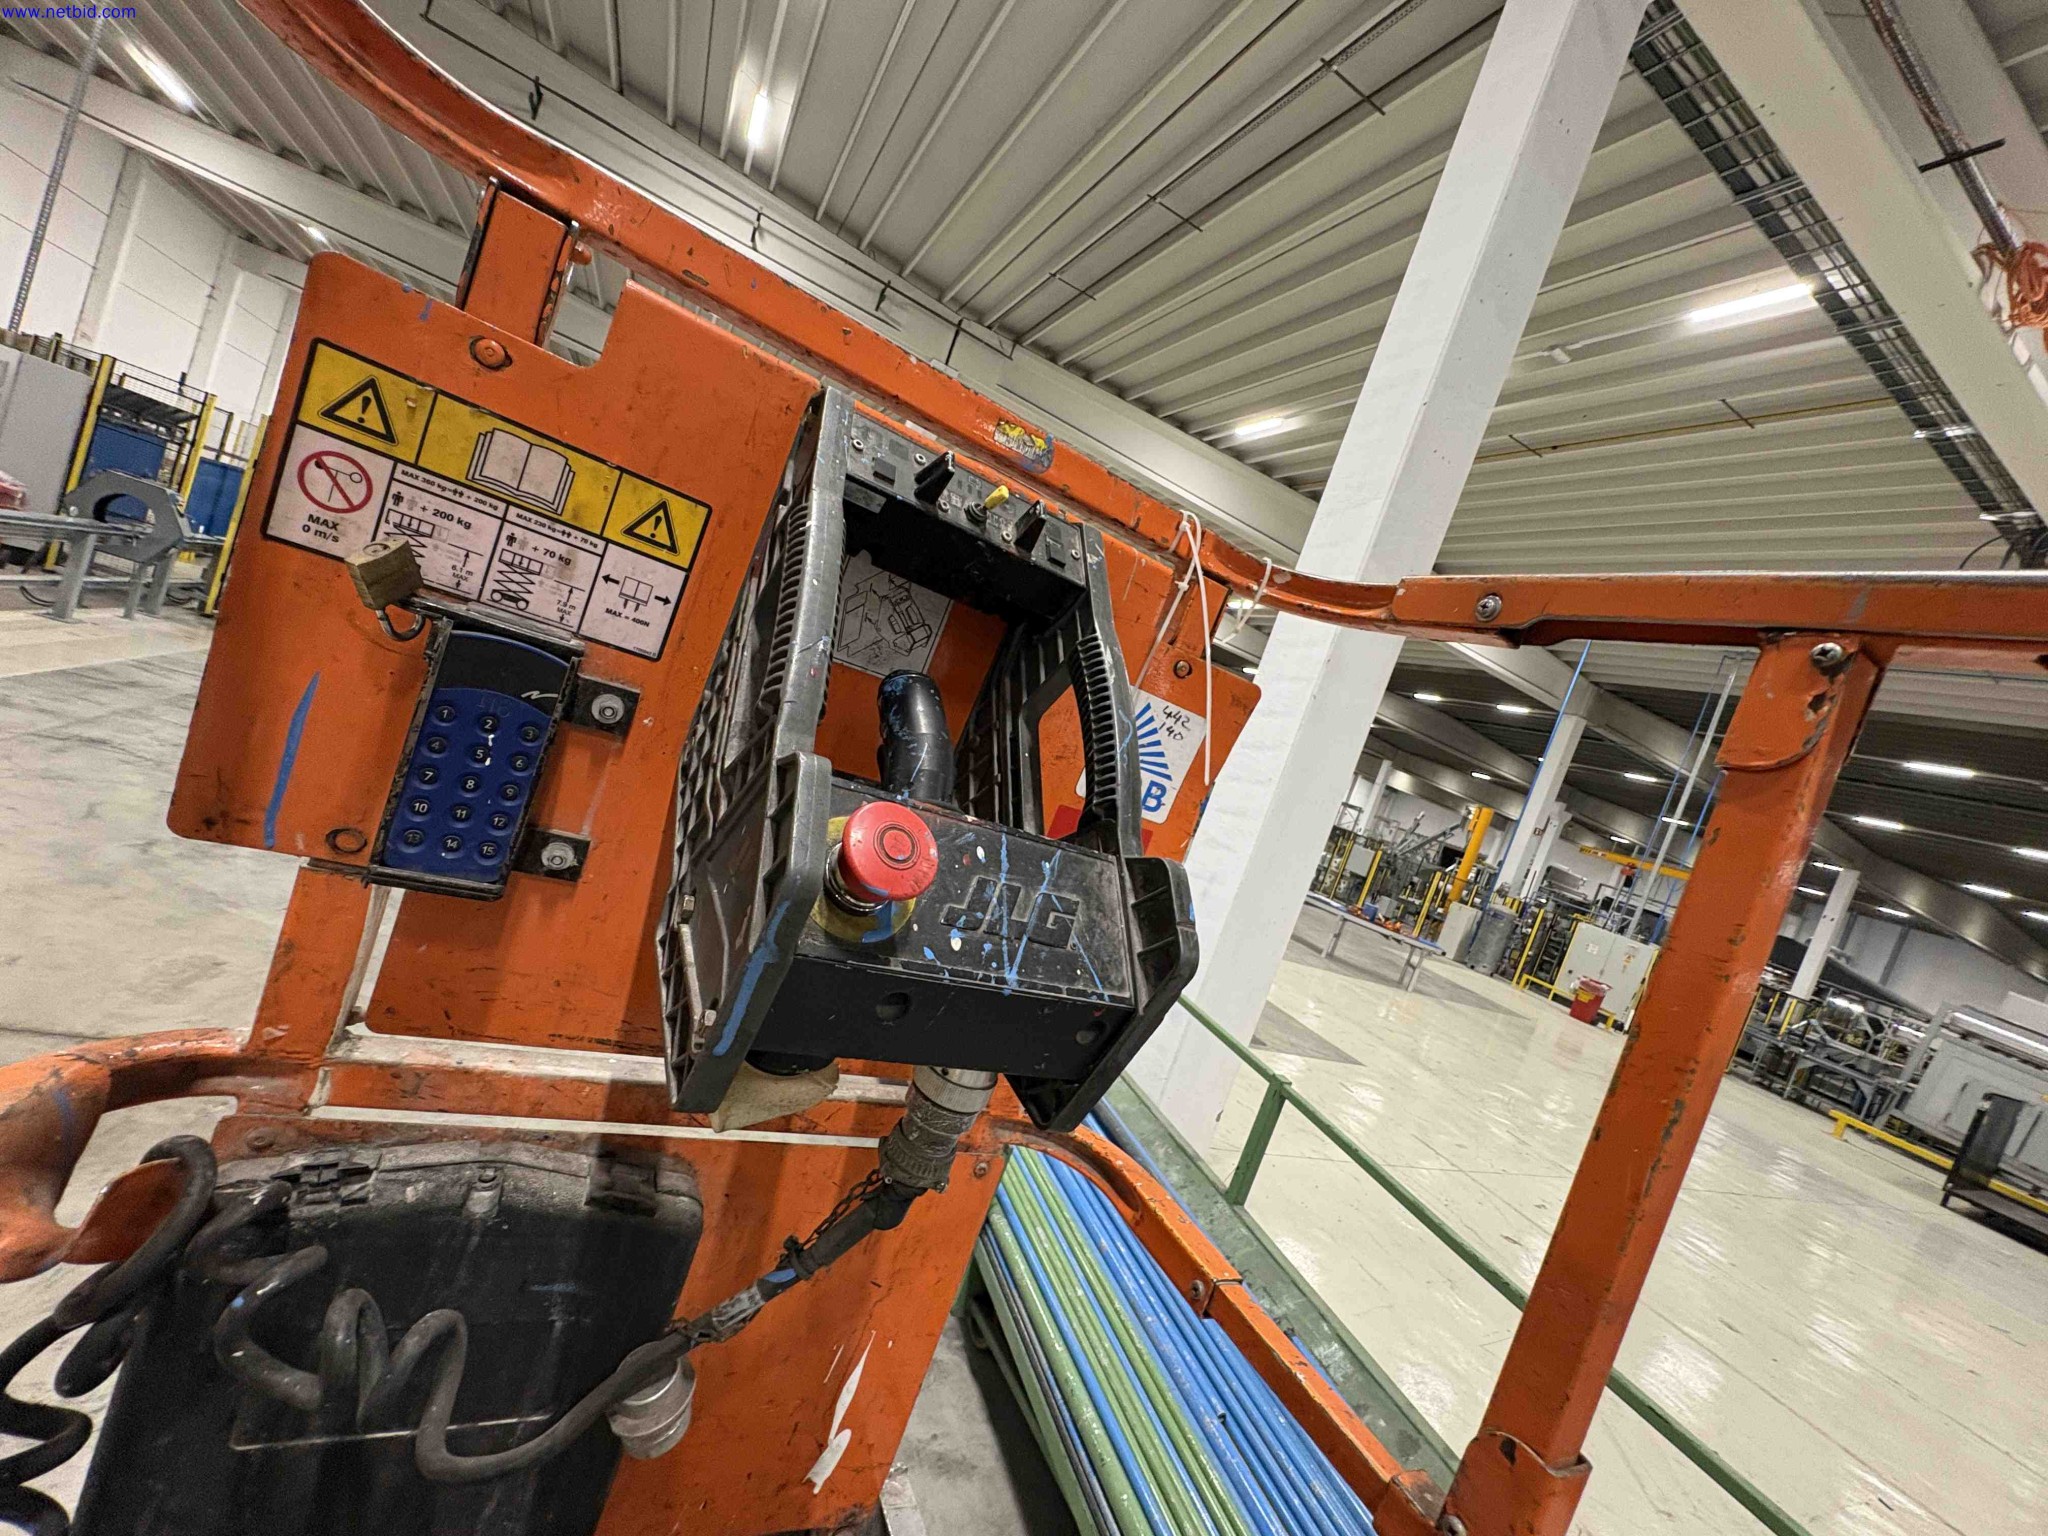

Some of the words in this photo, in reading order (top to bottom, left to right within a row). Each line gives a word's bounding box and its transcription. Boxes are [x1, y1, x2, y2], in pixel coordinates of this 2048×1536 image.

[401, 469, 420, 481] MAX
[474, 497, 487, 506] 200
[488, 502, 499, 511] kg
[307, 513, 340, 531] MAX
[432, 508, 454, 522] 200
[456, 517, 472, 530] kg
[302, 524, 311, 533] 0
[314, 529, 340, 543] m/s
[516, 513, 532, 523] MAX
[589, 541, 598, 549] kg
[543, 548, 556, 559] 70
[558, 554, 572, 566] kg
[451, 564, 463, 574] 6.1
[452, 572, 469, 582] MAX
[556, 607, 572, 616] MAX
[605, 608, 623, 618] MAX
[441, 709, 448, 718] 1
[1162, 705, 1191, 731] 442
[484, 719, 493, 730] 2
[526, 730, 533, 739] 3
[431, 741, 440, 750] 4
[475, 749, 484, 759] 5
[515, 759, 523, 768] 6
[423, 771, 434, 781] 7
[465, 779, 475, 790] 8
[506, 788, 514, 797] 9
[413, 802, 428, 813] 10
[455, 808, 467, 819] 11
[493, 816, 505, 827] 12
[445, 839, 458, 849] 14
[481, 845, 495, 856] 15
[940, 876, 1081, 950] JLG
